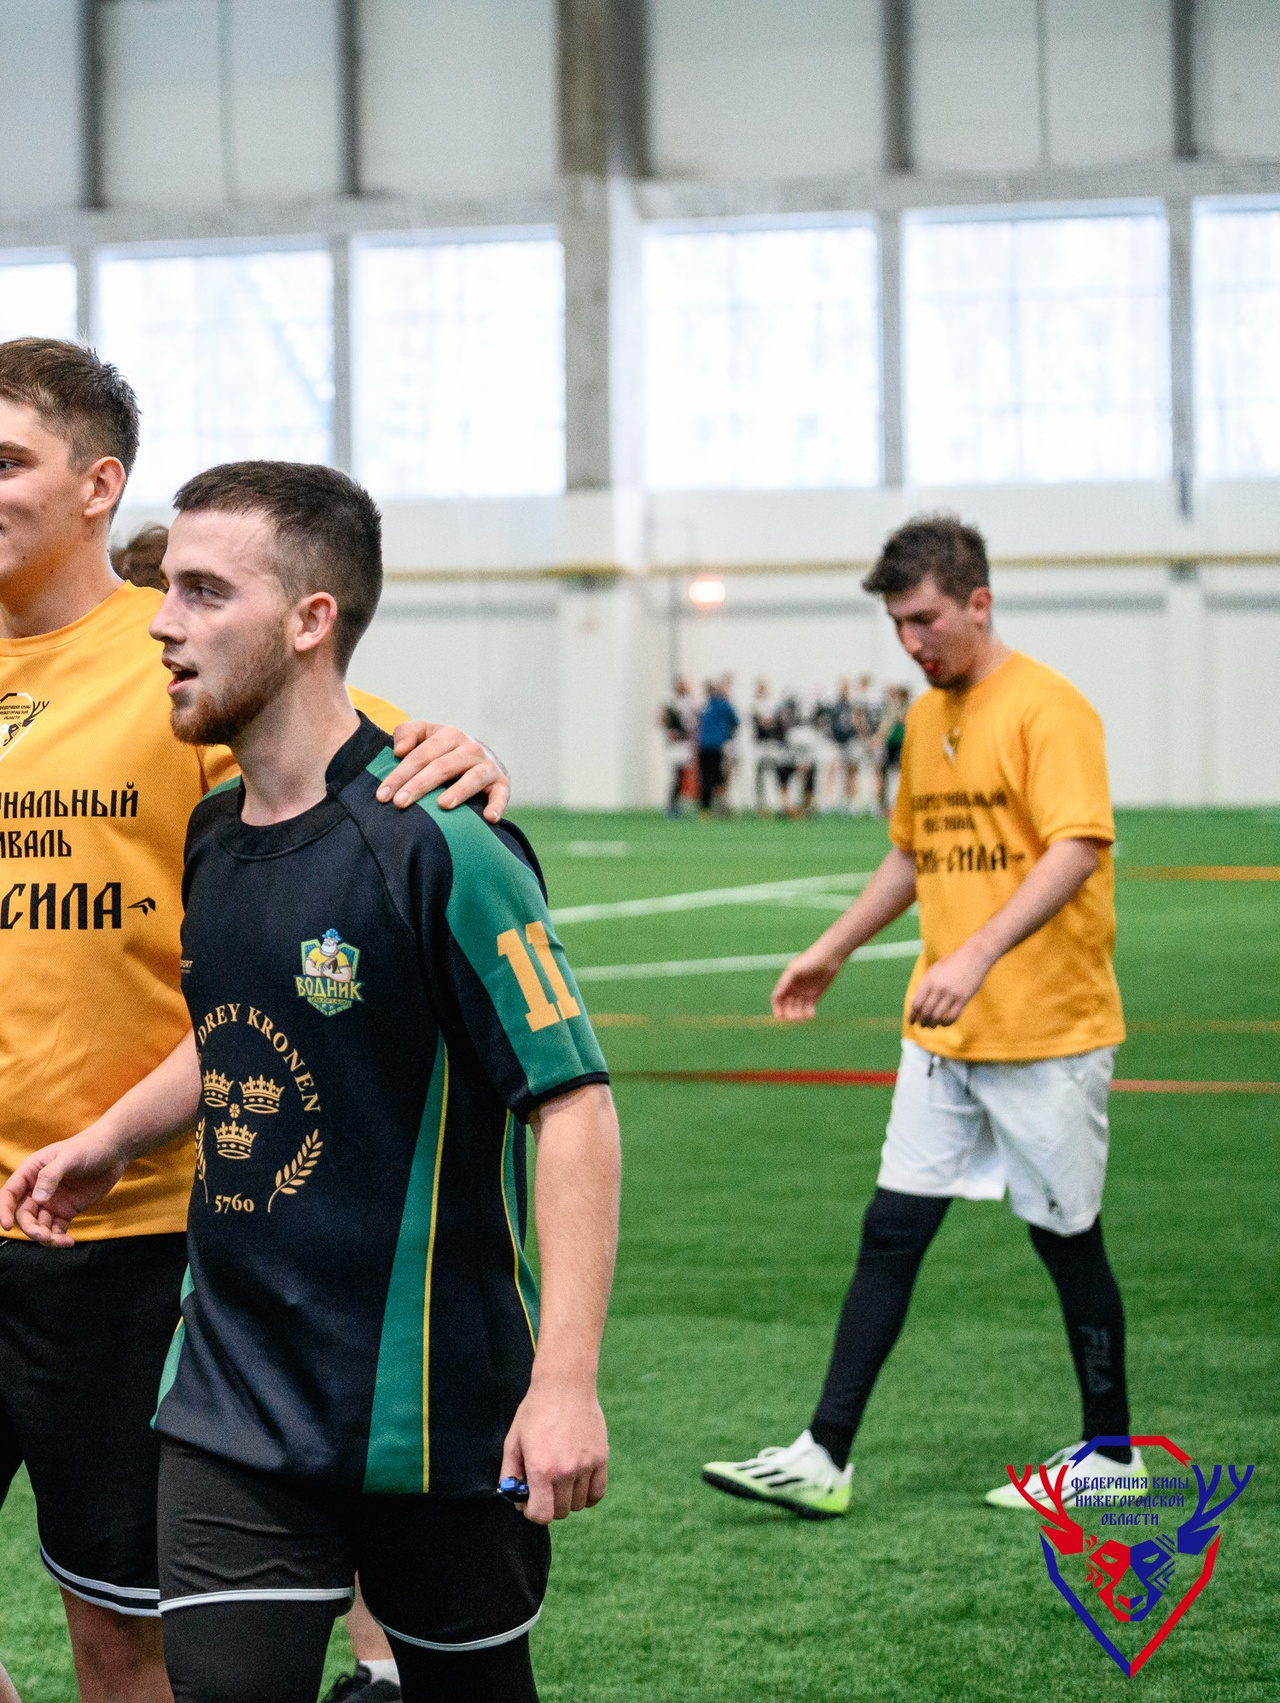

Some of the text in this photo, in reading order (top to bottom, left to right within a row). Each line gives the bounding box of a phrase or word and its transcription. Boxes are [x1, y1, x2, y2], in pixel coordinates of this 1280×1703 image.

[296, 976, 363, 1001] ВОДНИК
[497, 921, 581, 1032] 11
[196, 1003, 321, 1112] DREY KRONEN
[214, 1193, 255, 1214] 5760
